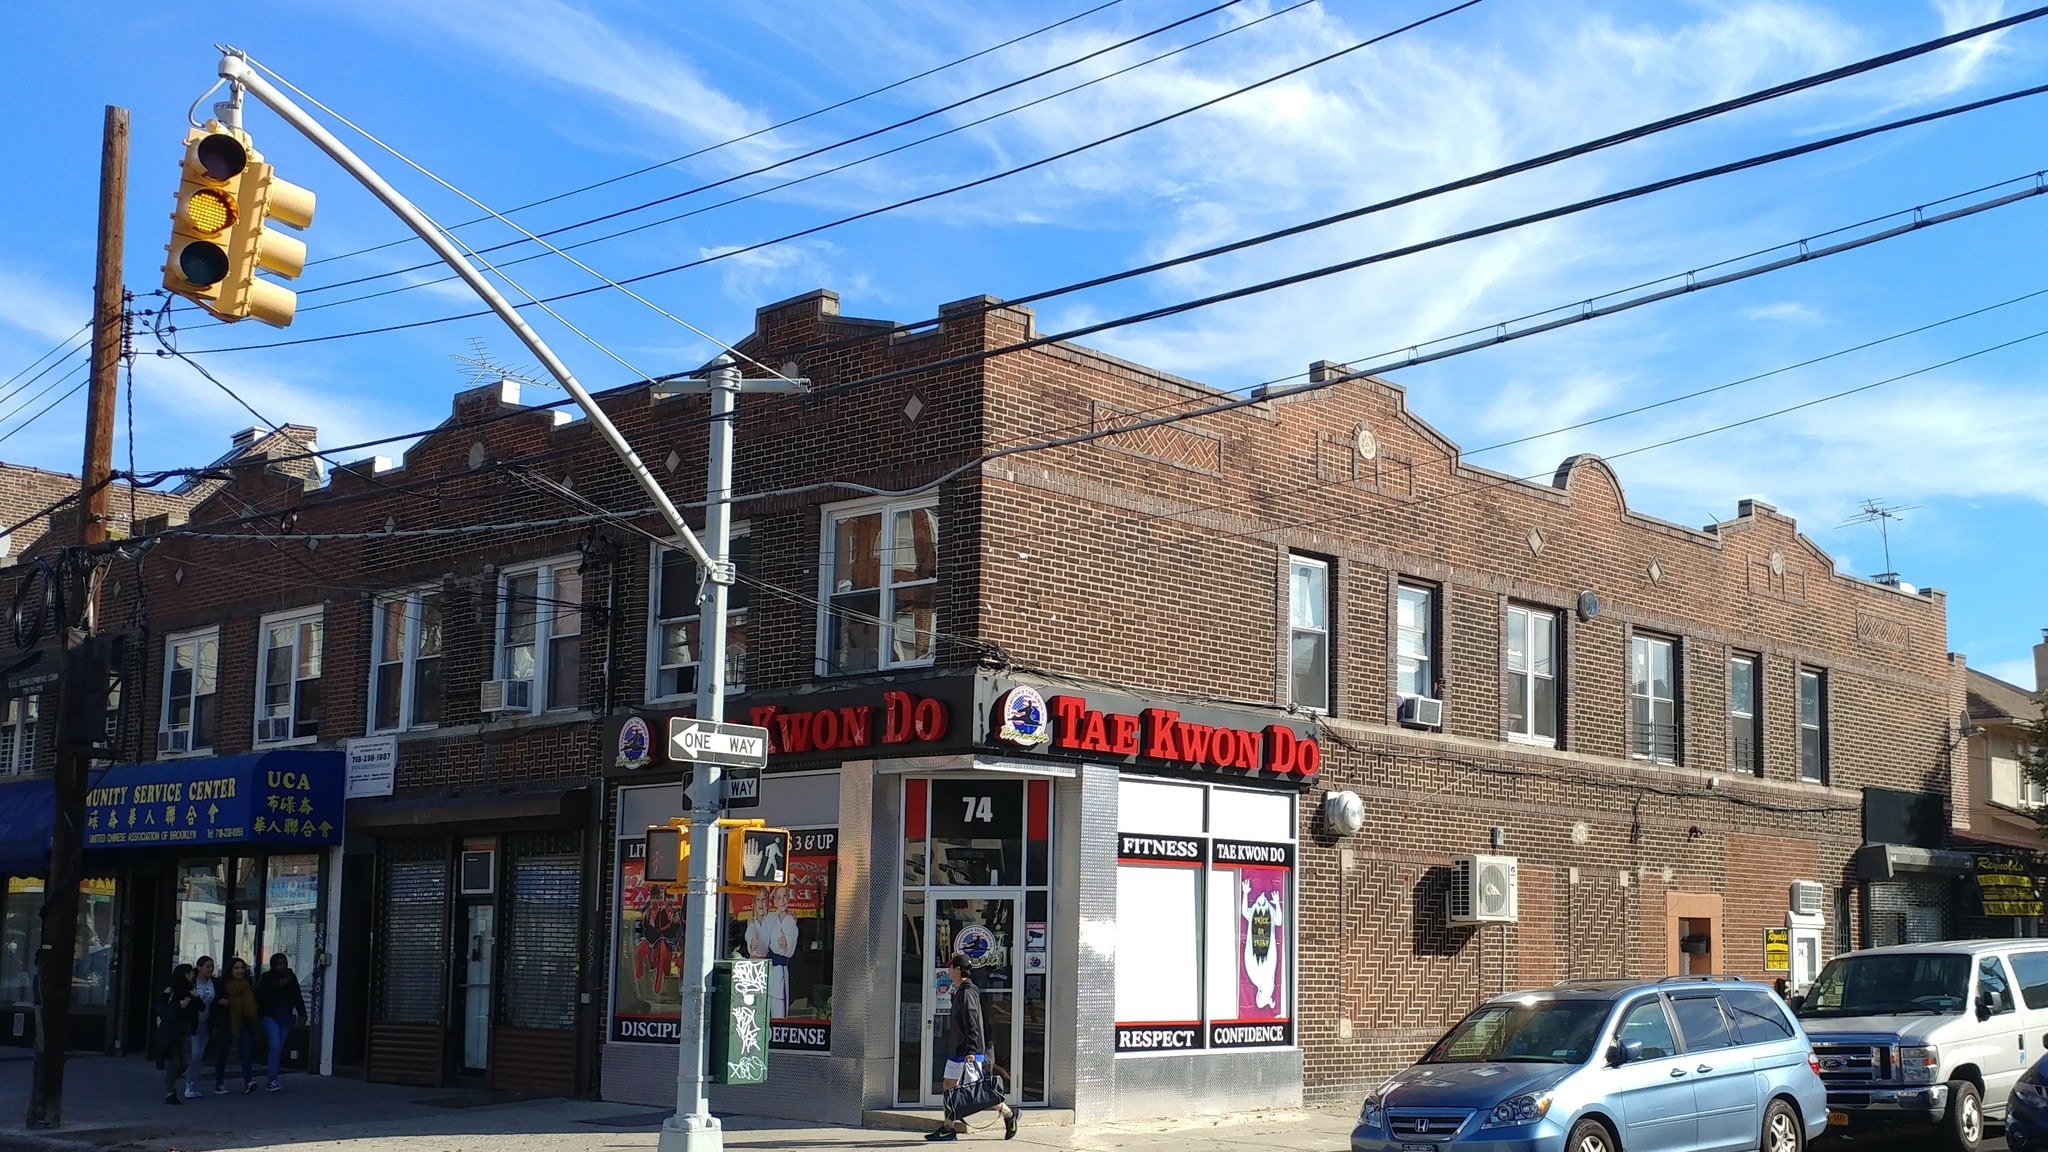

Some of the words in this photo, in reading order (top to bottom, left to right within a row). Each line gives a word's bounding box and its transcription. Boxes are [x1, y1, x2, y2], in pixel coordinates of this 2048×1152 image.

[684, 732, 712, 750] ONE
[729, 736, 756, 754] WAY
[267, 770, 311, 790] UCA
[731, 780, 755, 797] WAY
[133, 782, 182, 804] SERVICE
[188, 777, 236, 801] CENTER
[962, 796, 993, 823] 74
[89, 833, 105, 844] UNITED
[107, 832, 127, 843] CHINESE
[127, 831, 160, 842] ASSOCIATION
[161, 830, 169, 841] OF
[170, 829, 197, 841] BROOKLYN
[253, 816, 334, 839] 華人聯合會
[795, 835, 802, 851] 3
[804, 834, 815, 851] &
[816, 833, 834, 850] UP
[1122, 837, 1198, 858] FITNESS
[1216, 843, 1237, 860] TAE
[1237, 844, 1270, 862] KWON
[1270, 847, 1285, 863] DO
[1977, 856, 2024, 873] Reynolds
[1119, 1030, 1195, 1048] RESPECT
[1214, 1025, 1284, 1045] CONFIDENCE
